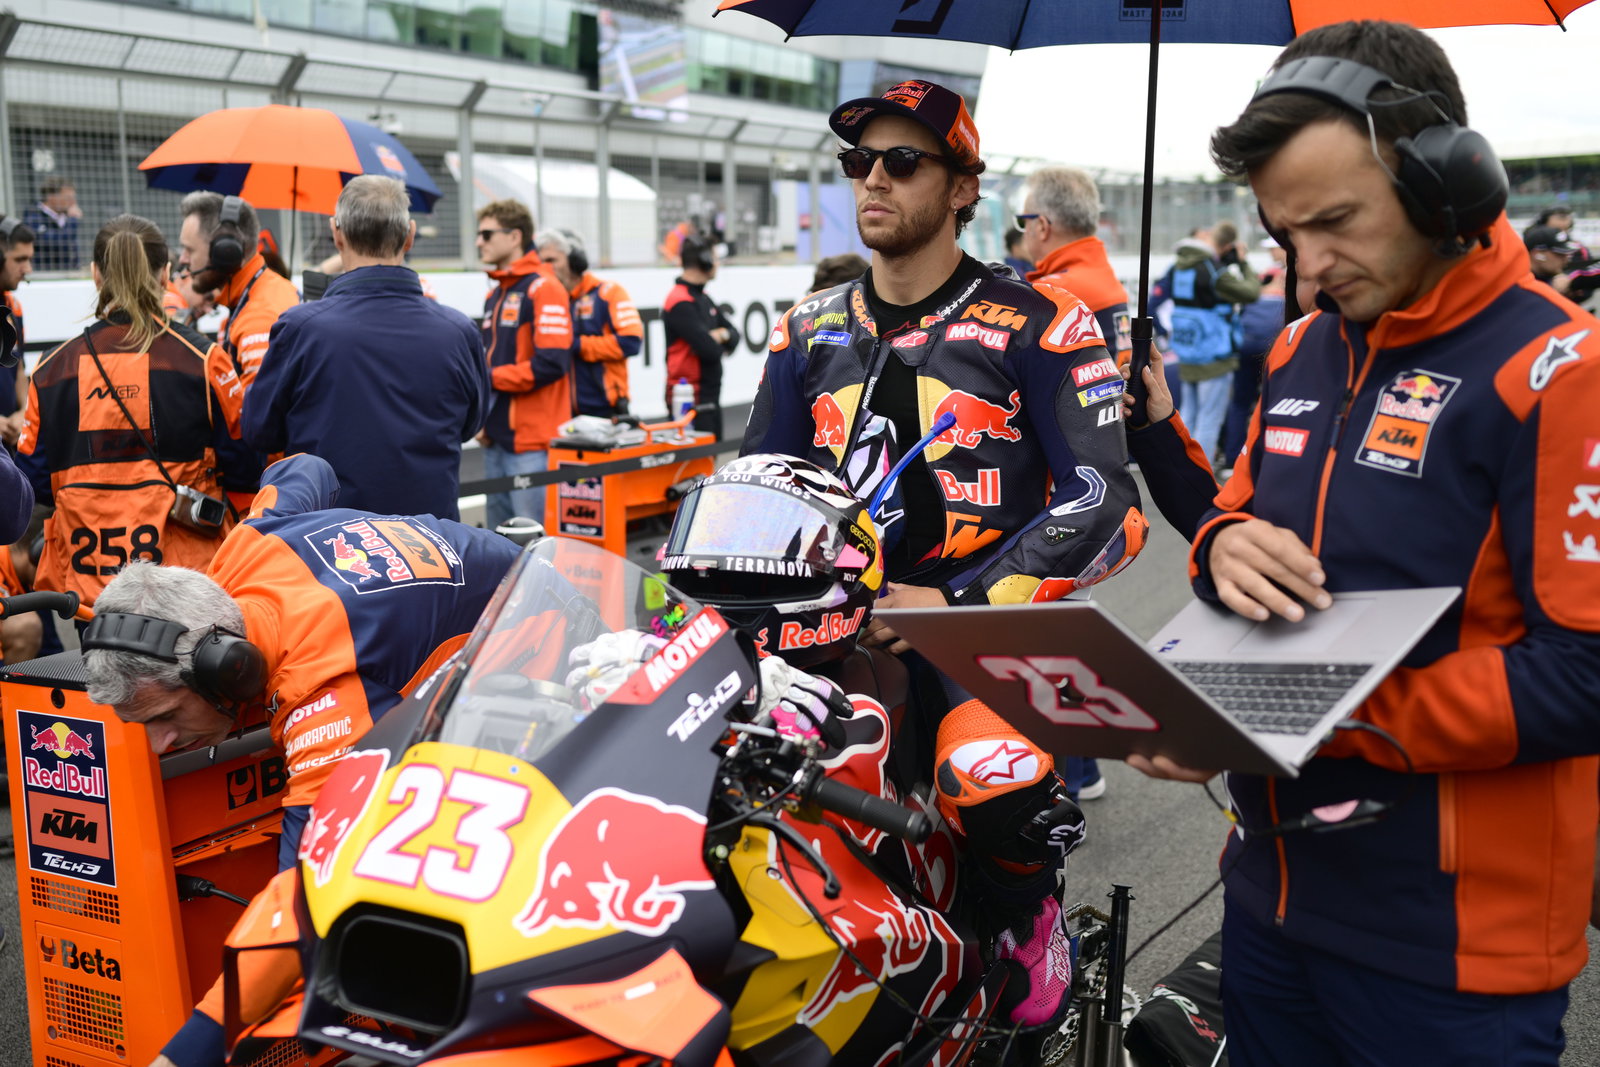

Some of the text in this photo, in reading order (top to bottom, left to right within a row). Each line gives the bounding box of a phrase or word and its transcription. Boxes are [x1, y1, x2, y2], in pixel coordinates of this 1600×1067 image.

[960, 299, 1029, 332] KTM
[947, 323, 1005, 348] MOTUL
[1265, 430, 1305, 453] MOTUL
[1377, 426, 1418, 448] KTM
[687, 473, 812, 501] GIVES YOU WINGS
[934, 468, 1001, 506] Bull
[71, 525, 164, 575] 258
[388, 526, 438, 567] KTM
[726, 557, 813, 578] TERRANOVA
[645, 613, 722, 692] MOTUL
[283, 692, 337, 734] MOTUL
[40, 808, 98, 844] KTM
[352, 762, 533, 904] 23
[60, 938, 122, 982] Beta
